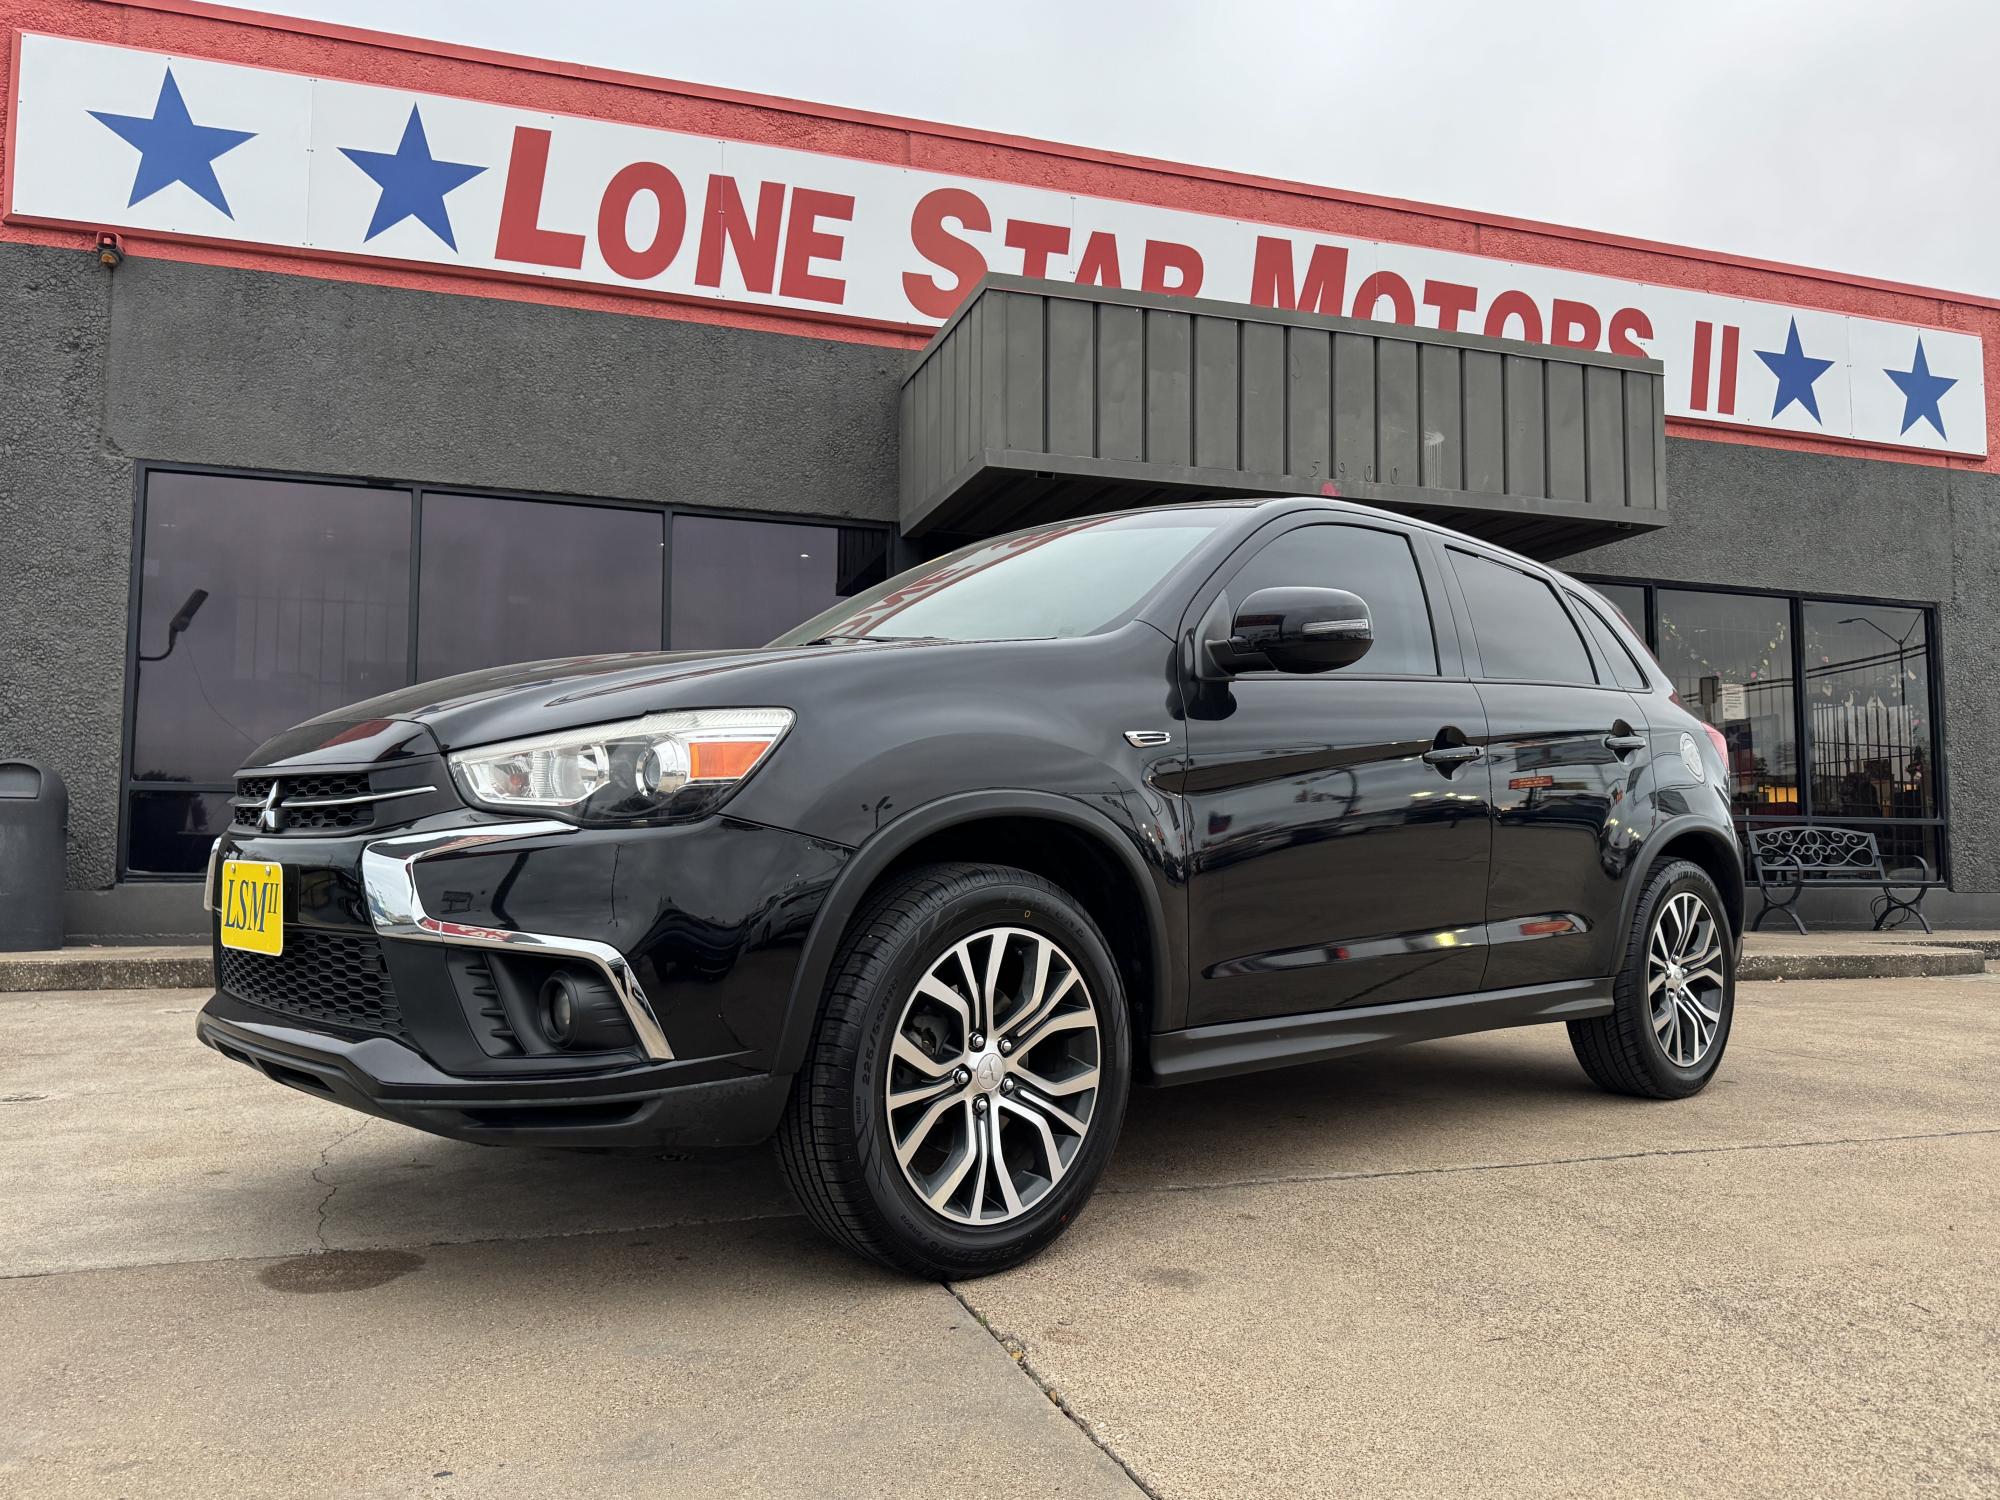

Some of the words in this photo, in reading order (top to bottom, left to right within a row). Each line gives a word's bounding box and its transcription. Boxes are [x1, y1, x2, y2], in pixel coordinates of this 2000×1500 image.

[495, 127, 855, 305] LONE
[903, 188, 1204, 318] STAR
[1251, 236, 1653, 358] MOTORS
[1690, 321, 1739, 416] II
